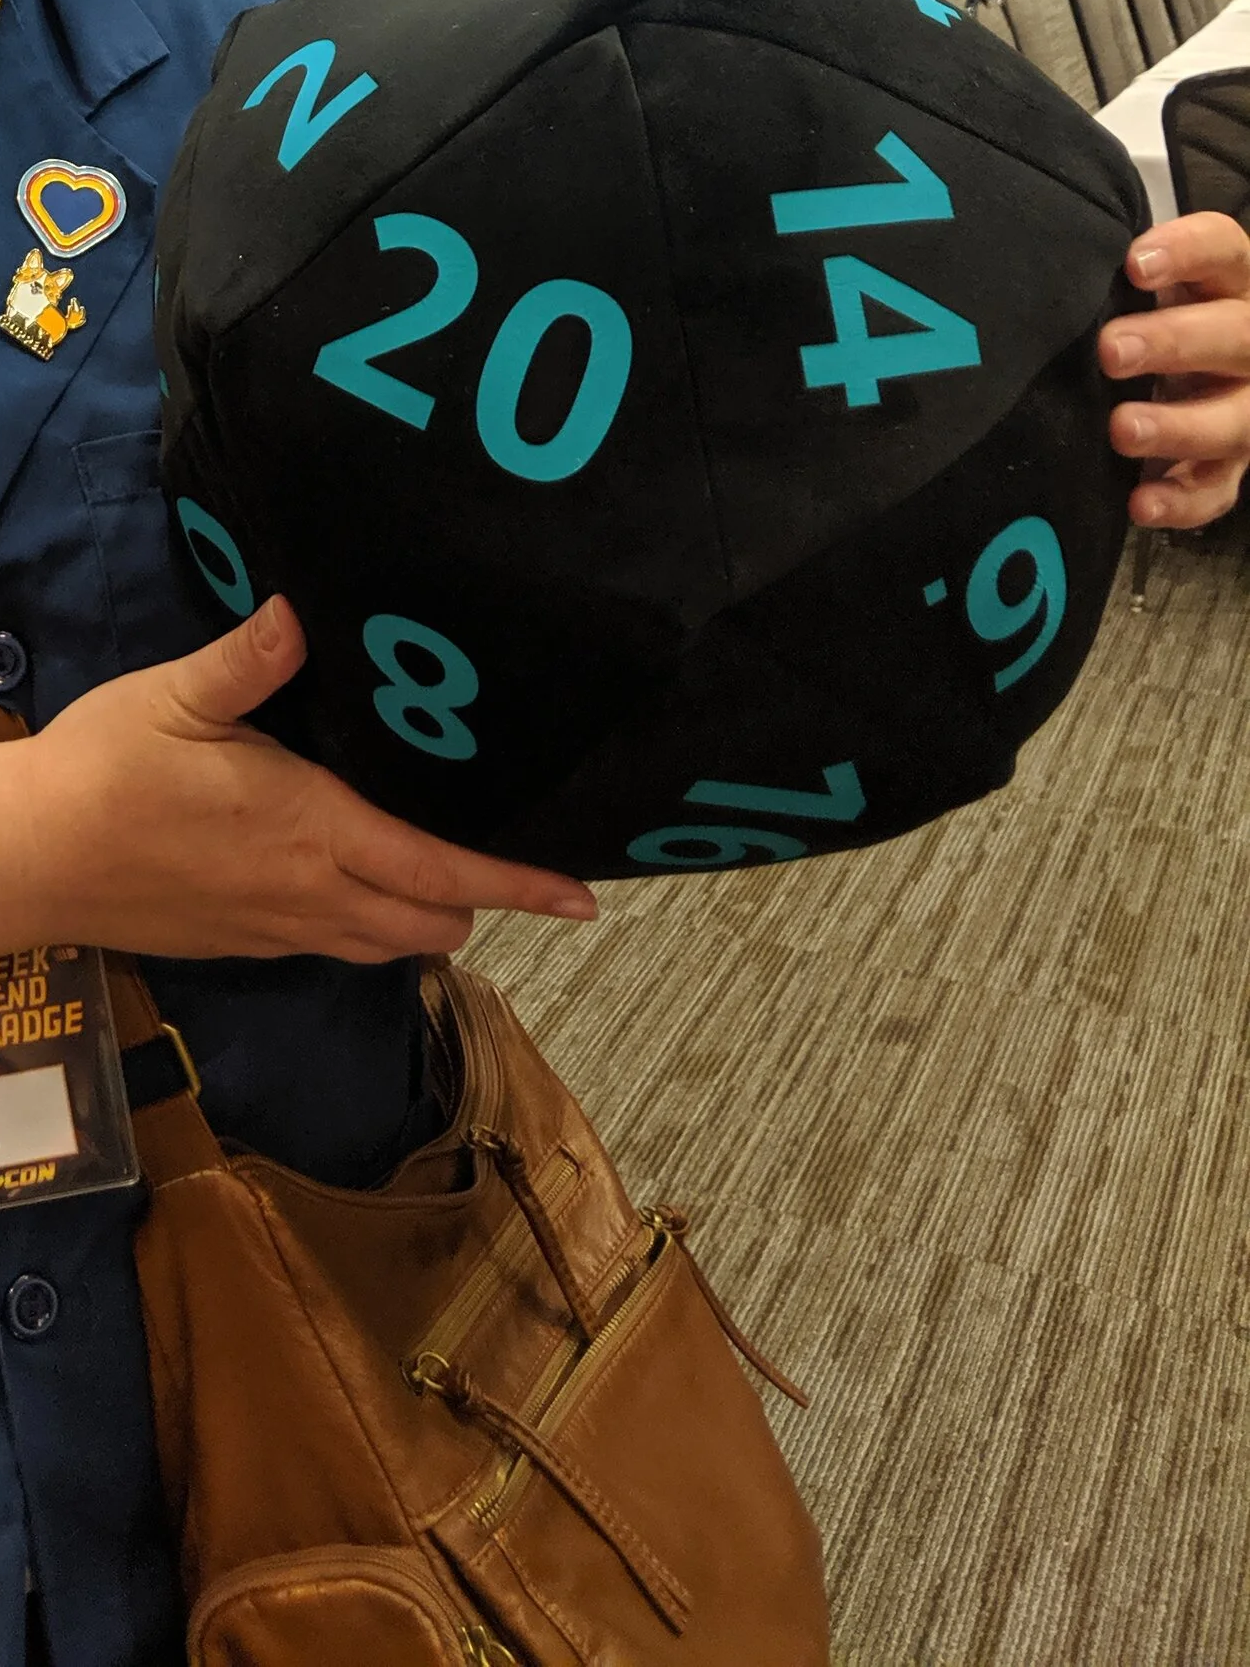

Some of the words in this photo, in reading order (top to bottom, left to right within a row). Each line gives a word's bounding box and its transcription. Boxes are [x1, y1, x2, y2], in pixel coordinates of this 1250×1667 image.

[242, 37, 380, 173] 2
[768, 130, 983, 409] 14
[312, 211, 634, 484] 20
[362, 614, 479, 760] 8
[627, 761, 867, 866] 16
